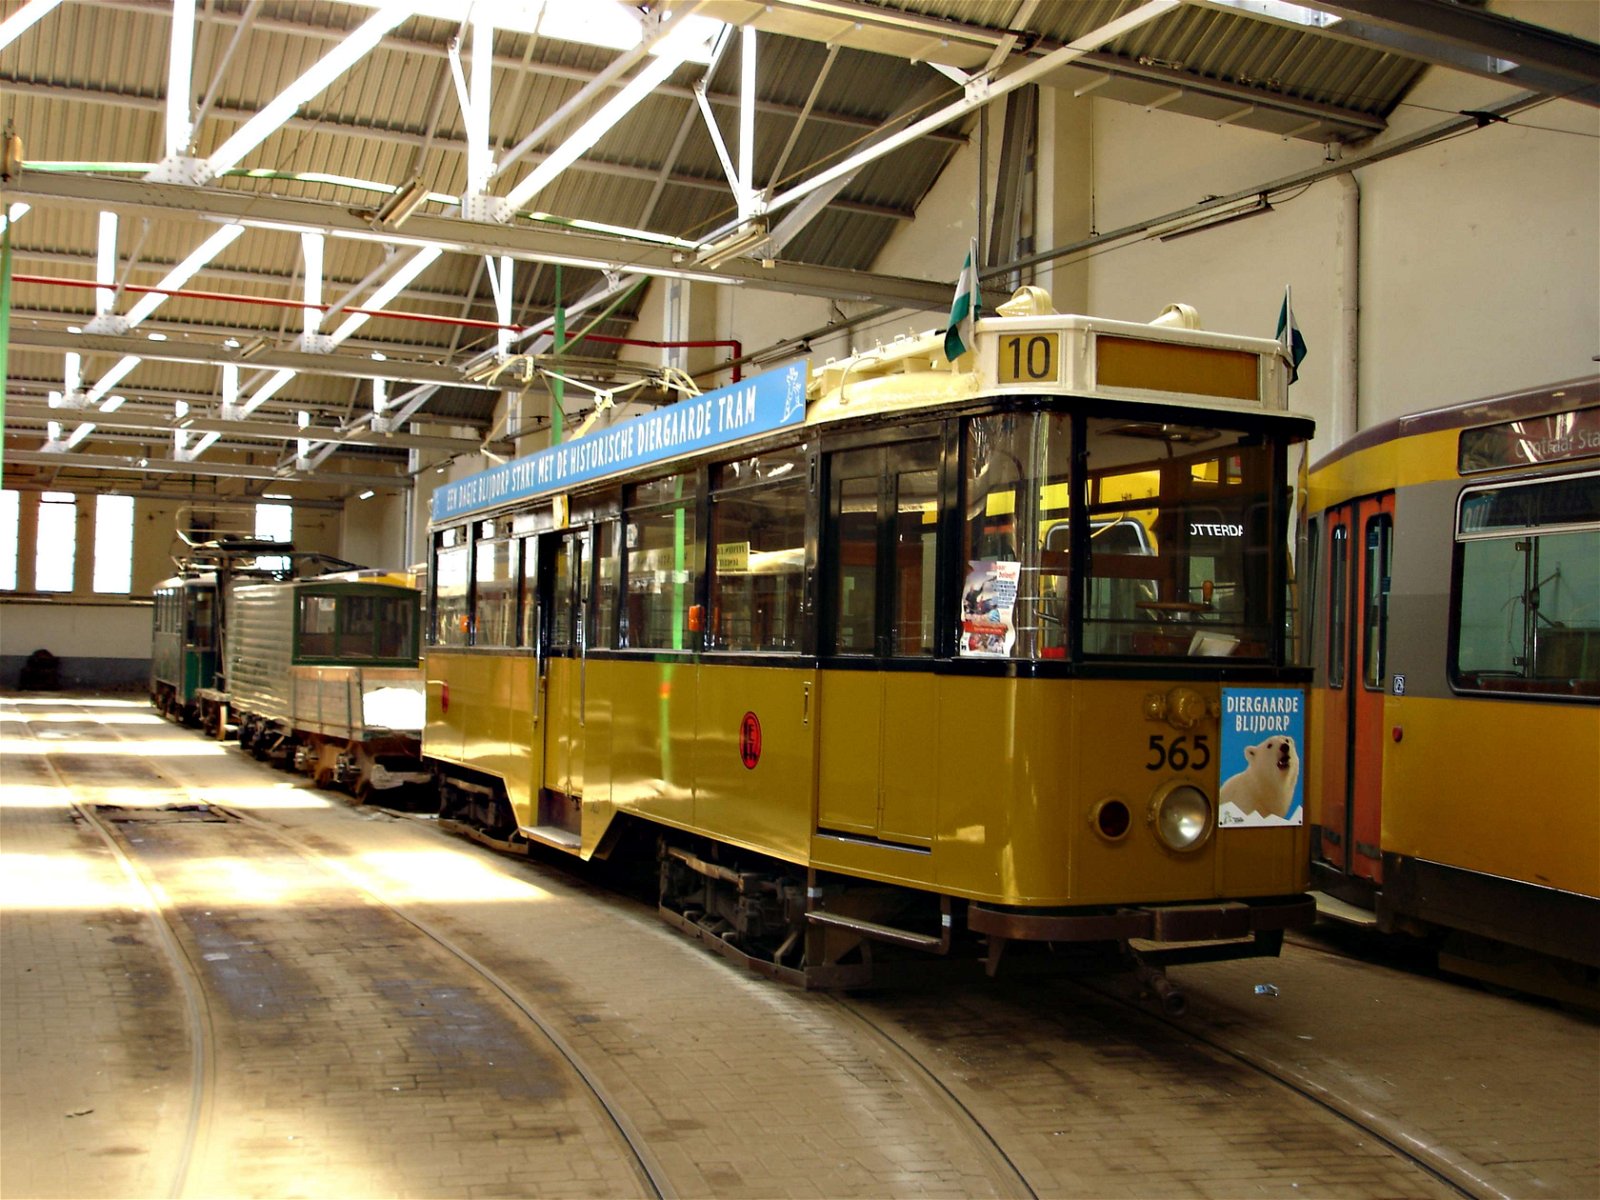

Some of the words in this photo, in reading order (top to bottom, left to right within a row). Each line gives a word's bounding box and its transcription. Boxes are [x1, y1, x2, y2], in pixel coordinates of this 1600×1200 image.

[1009, 336, 1050, 379] 10
[447, 487, 458, 512] EEN
[479, 470, 509, 503] BLIJDORP
[512, 461, 536, 492] START
[538, 454, 554, 484] MET
[557, 449, 568, 480] DE
[570, 426, 634, 475] HISTORISCHE
[638, 400, 712, 456] DIERGAARDE
[718, 385, 756, 432] TRAM
[1227, 696, 1299, 713] DIERGAARDE
[1235, 715, 1290, 734] BLIJDORP
[1146, 735, 1210, 771] 565
